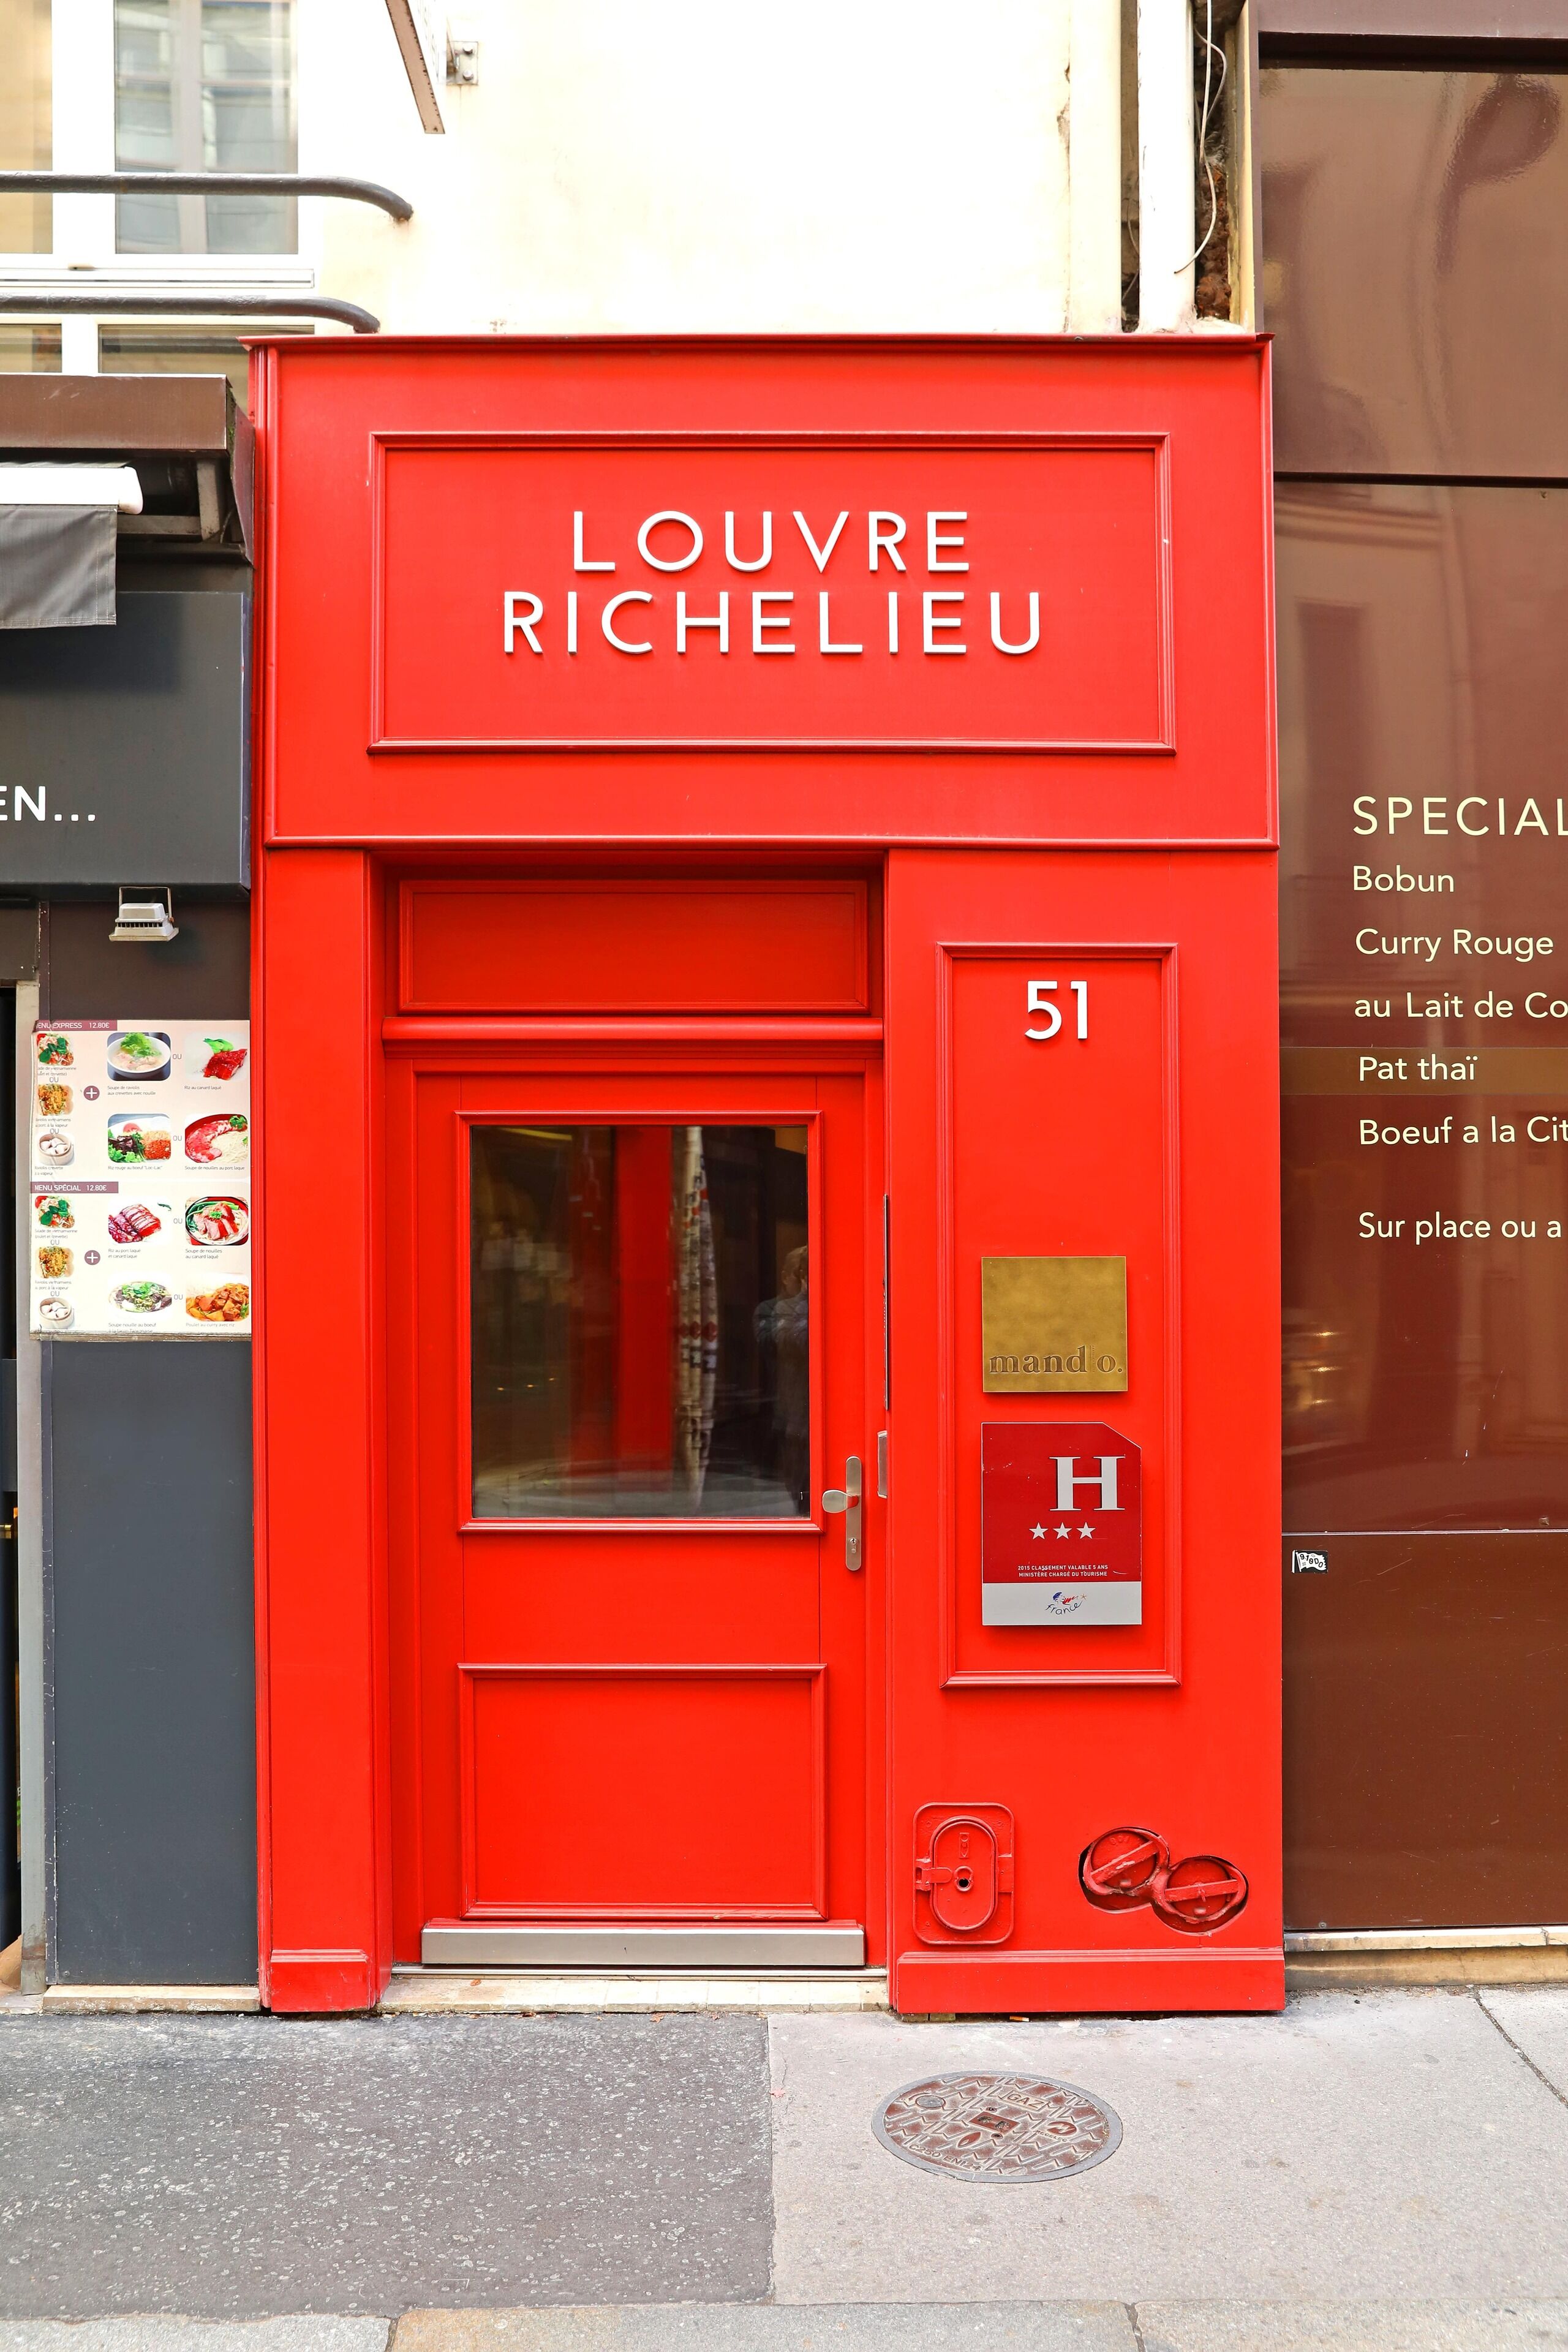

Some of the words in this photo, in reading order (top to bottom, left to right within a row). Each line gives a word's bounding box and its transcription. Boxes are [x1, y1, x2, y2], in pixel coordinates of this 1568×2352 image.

[573, 510, 970, 574] LOUVRE
[503, 590, 1041, 655] RICHELIEU
[1353, 796, 1568, 836] SPECIAL
[1353, 864, 1455, 892] Bobun
[1355, 928, 1442, 962] Curry
[1453, 929, 1554, 963] Rouge
[1024, 981, 1088, 1040] 51
[1354, 999, 1390, 1017] au
[1406, 992, 1464, 1018] Lait
[1474, 990, 1514, 1018] de
[1525, 992, 1568, 1018] Co
[1359, 1056, 1408, 1081] Pat
[1417, 1054, 1479, 1080] thaï
[1359, 1116, 1453, 1145] Boeuf
[1462, 1125, 1479, 1143] a
[1491, 1115, 1515, 1142] la
[1526, 1115, 1568, 1142] Cit
[1359, 1212, 1406, 1238] Sur
[1415, 1211, 1491, 1245] place
[1501, 1220, 1536, 1238] ou
[1547, 1220, 1562, 1238] a
[989, 1344, 1087, 1373] mand
[1049, 1456, 1126, 1510] H
[1007, 2093, 1045, 2108] GAZ
